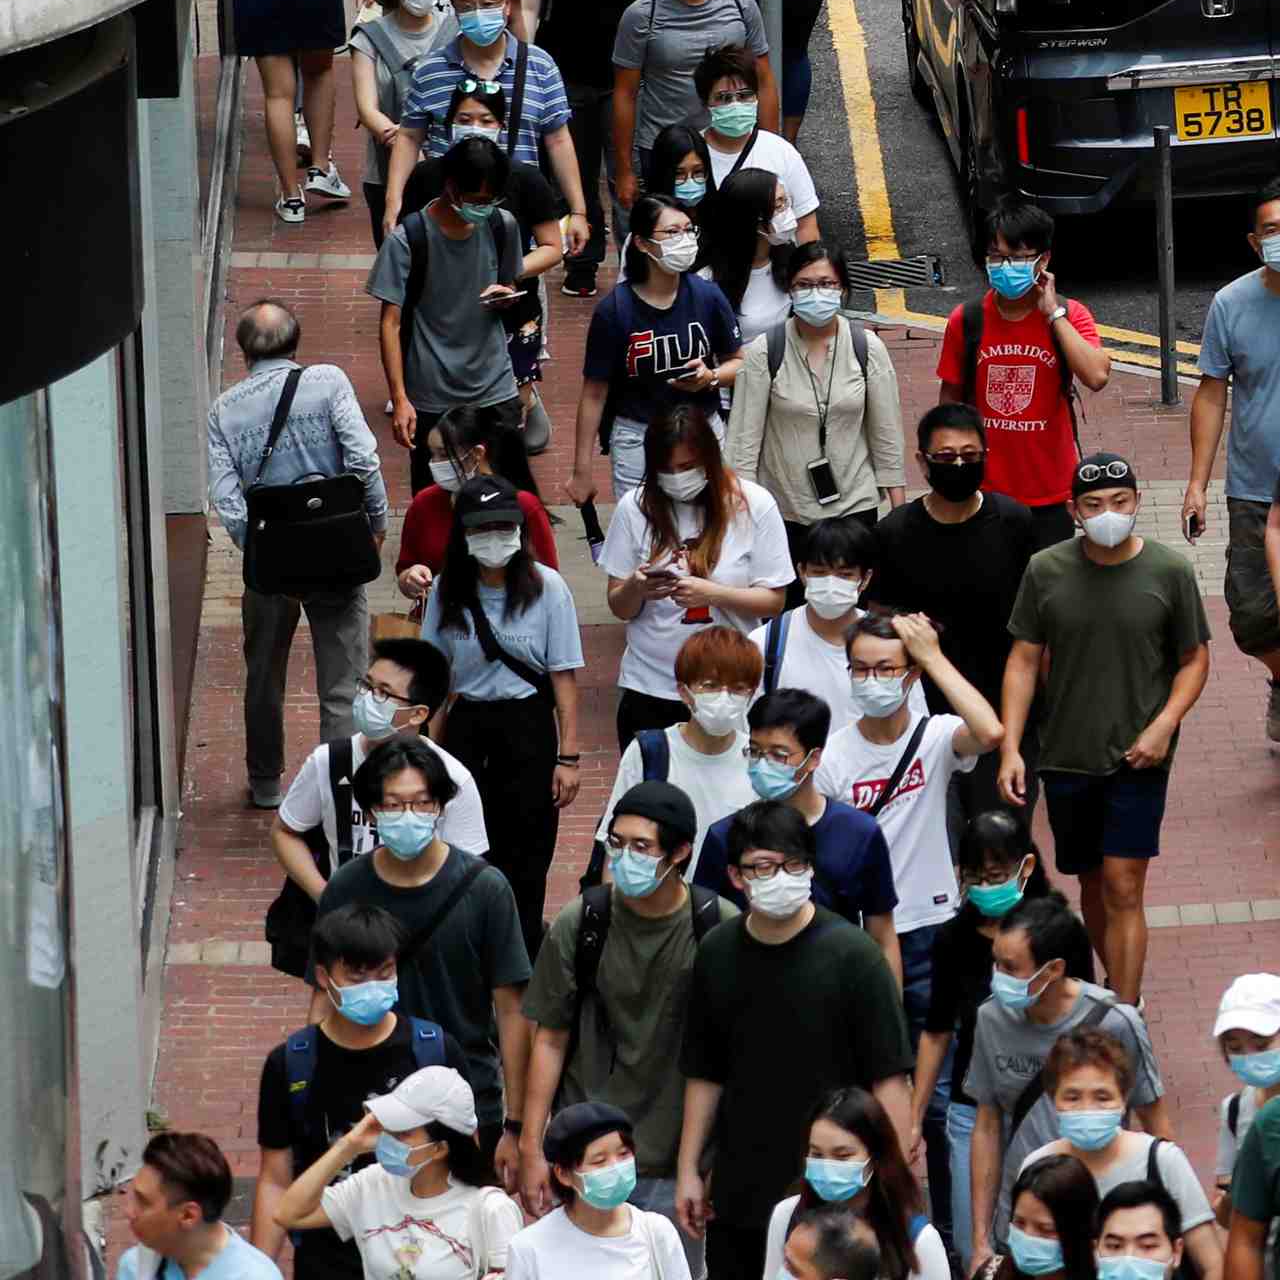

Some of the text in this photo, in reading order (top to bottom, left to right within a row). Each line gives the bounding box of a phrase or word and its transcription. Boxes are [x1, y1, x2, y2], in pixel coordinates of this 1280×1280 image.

[1202, 87, 1243, 112] TR
[1183, 109, 1265, 137] 5738
[626, 320, 712, 377] FILA
